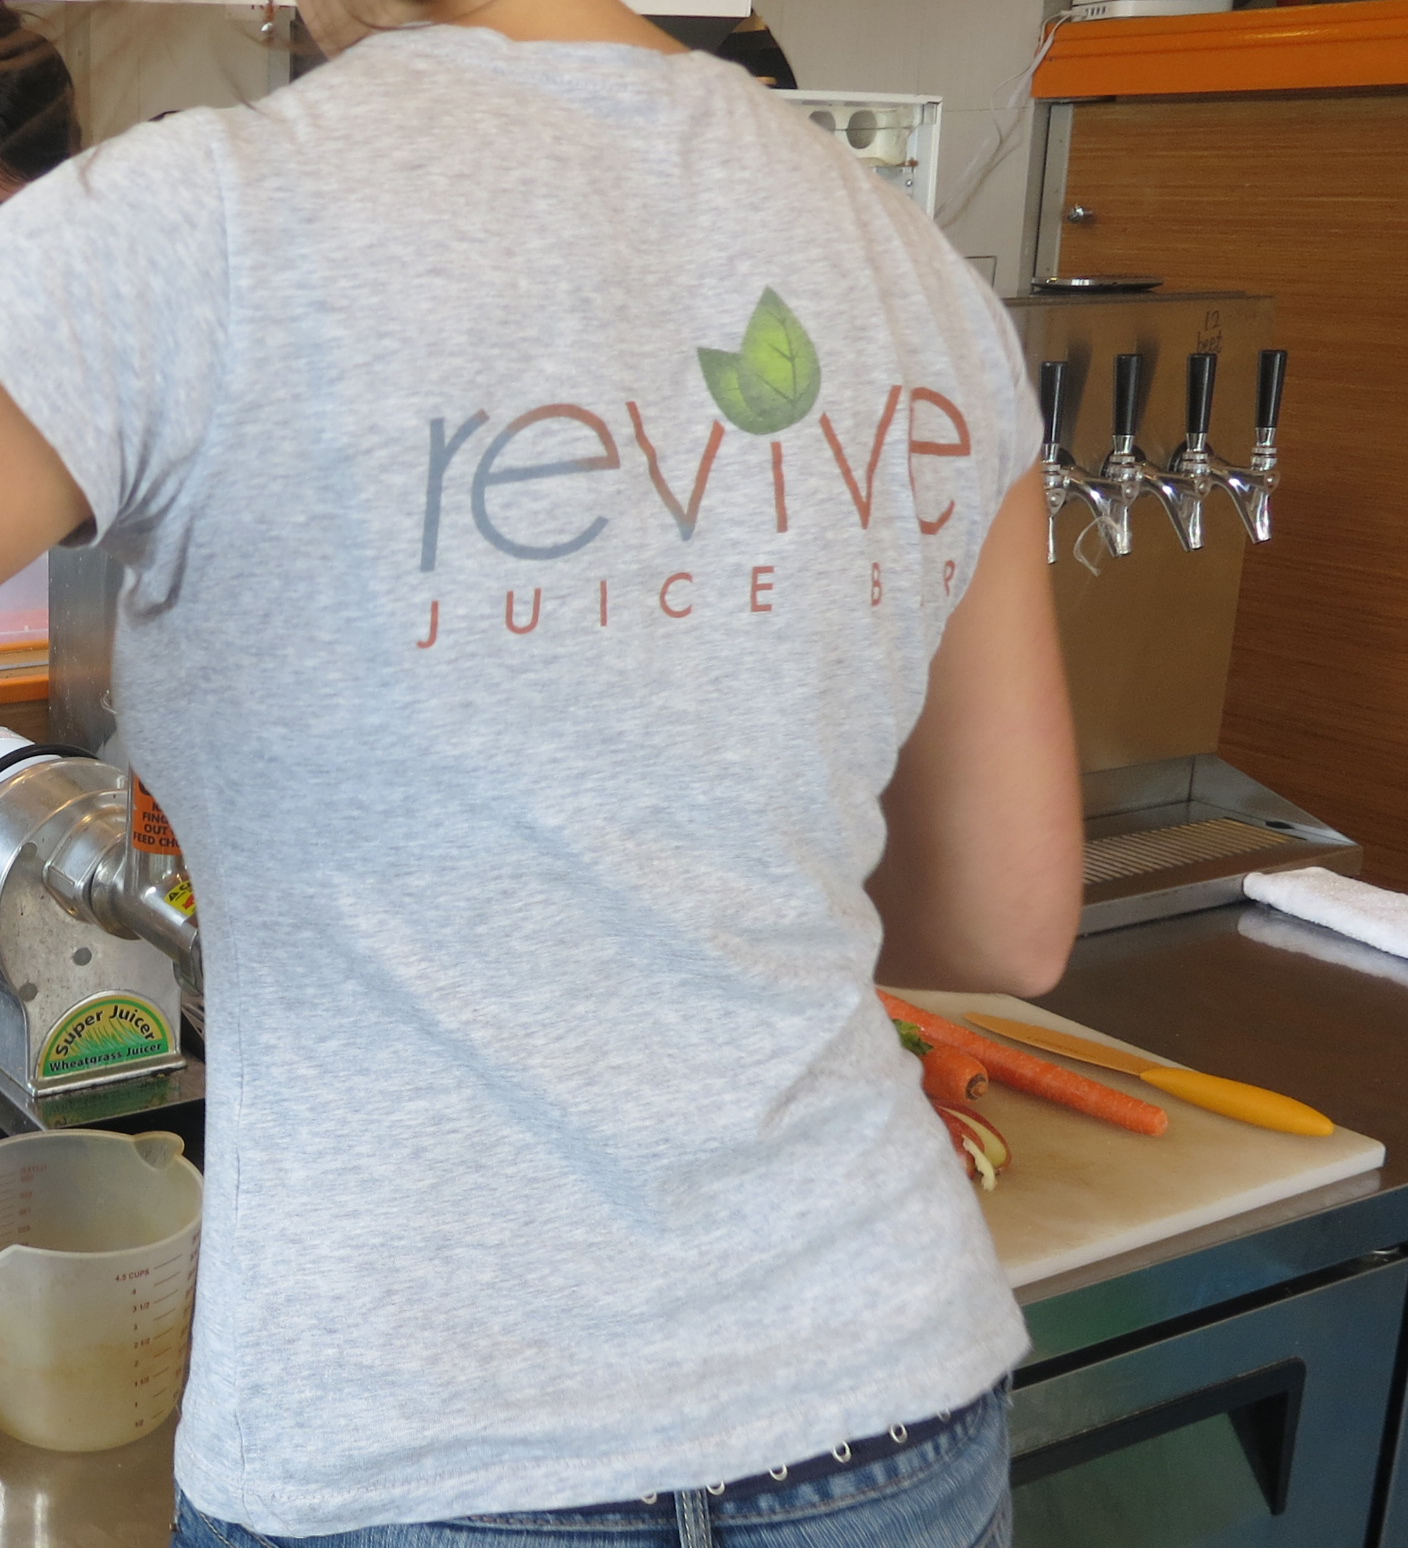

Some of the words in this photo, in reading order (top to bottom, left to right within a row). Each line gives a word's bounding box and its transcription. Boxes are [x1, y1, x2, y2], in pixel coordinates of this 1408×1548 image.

[420, 385, 971, 572] revive
[416, 566, 774, 649] JUICE
[143, 811, 169, 824] FING
[133, 831, 155, 845] FEED
[144, 823, 168, 835] OUT
[56, 1010, 103, 1057] Super
[109, 1005, 156, 1041] Juicer
[50, 1051, 123, 1071] Wheatgrass
[126, 1043, 162, 1057] Juicer
[128, 1268, 150, 1279] CUPS
